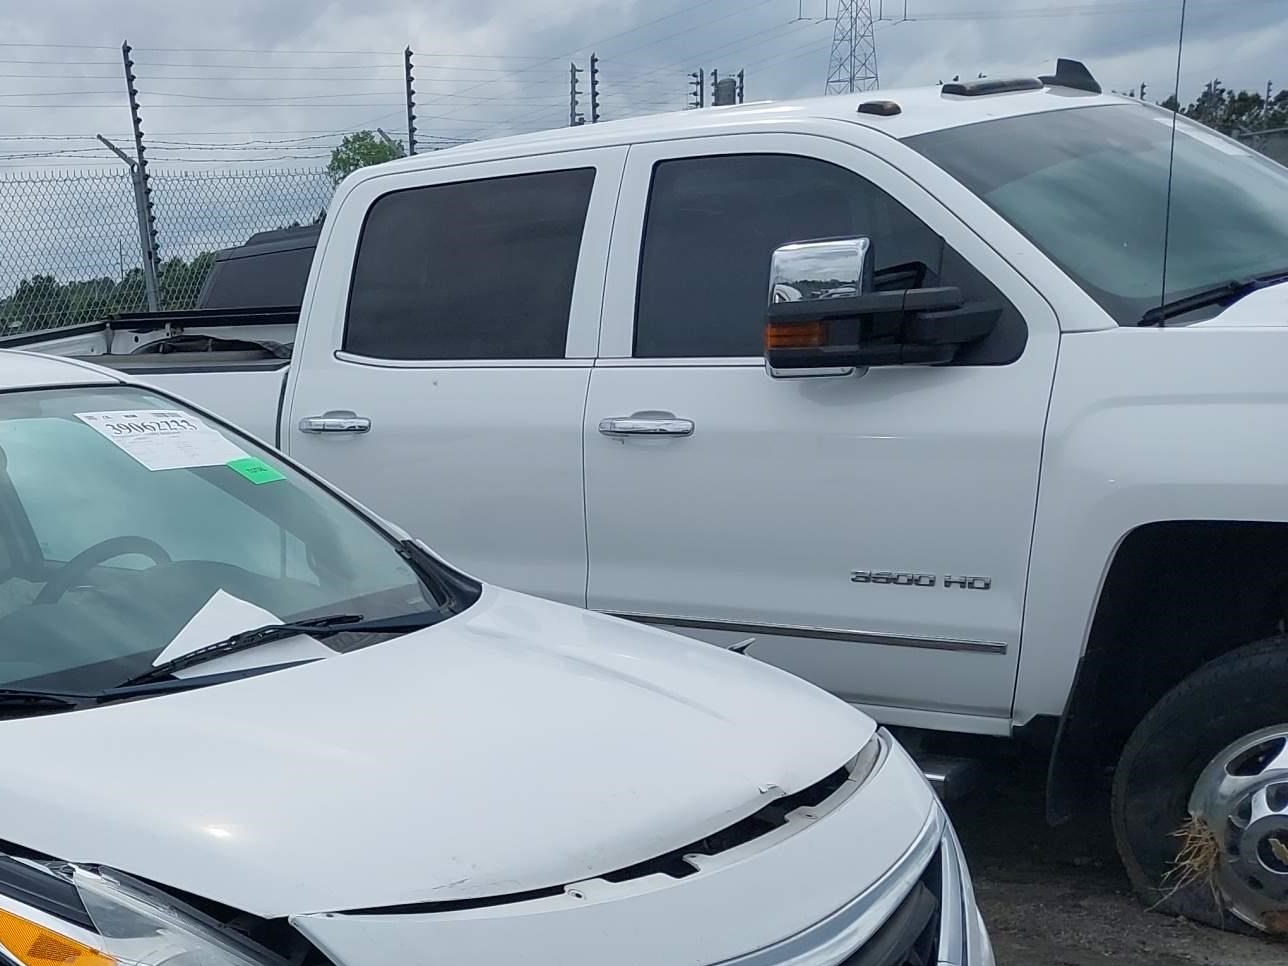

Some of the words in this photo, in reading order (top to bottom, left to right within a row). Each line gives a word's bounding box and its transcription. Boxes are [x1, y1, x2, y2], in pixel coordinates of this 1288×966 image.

[105, 419, 198, 435] 39062233
[850, 570, 936, 587] 3500
[943, 575, 992, 590] HD
